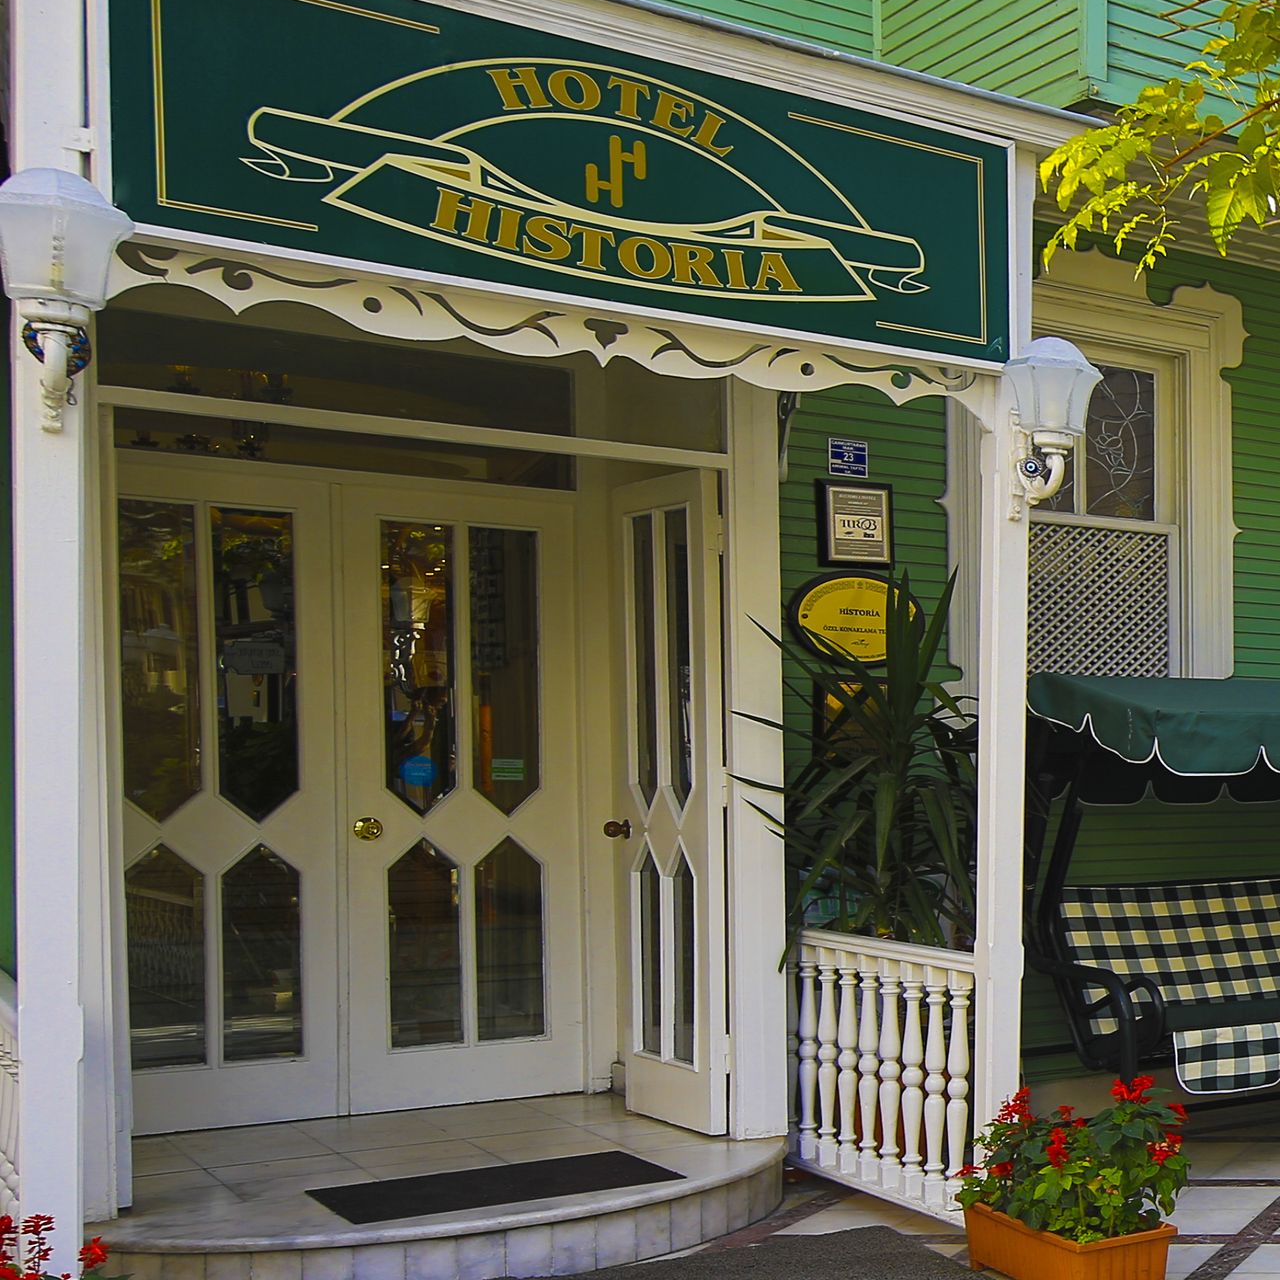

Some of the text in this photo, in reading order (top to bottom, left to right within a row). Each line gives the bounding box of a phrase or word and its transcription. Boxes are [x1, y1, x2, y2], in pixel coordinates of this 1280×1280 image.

[486, 66, 734, 158] HOTEL
[431, 187, 803, 293] HISTORIA
[843, 452, 854, 462] 23
[840, 626, 877, 634] KONAKLAMA
